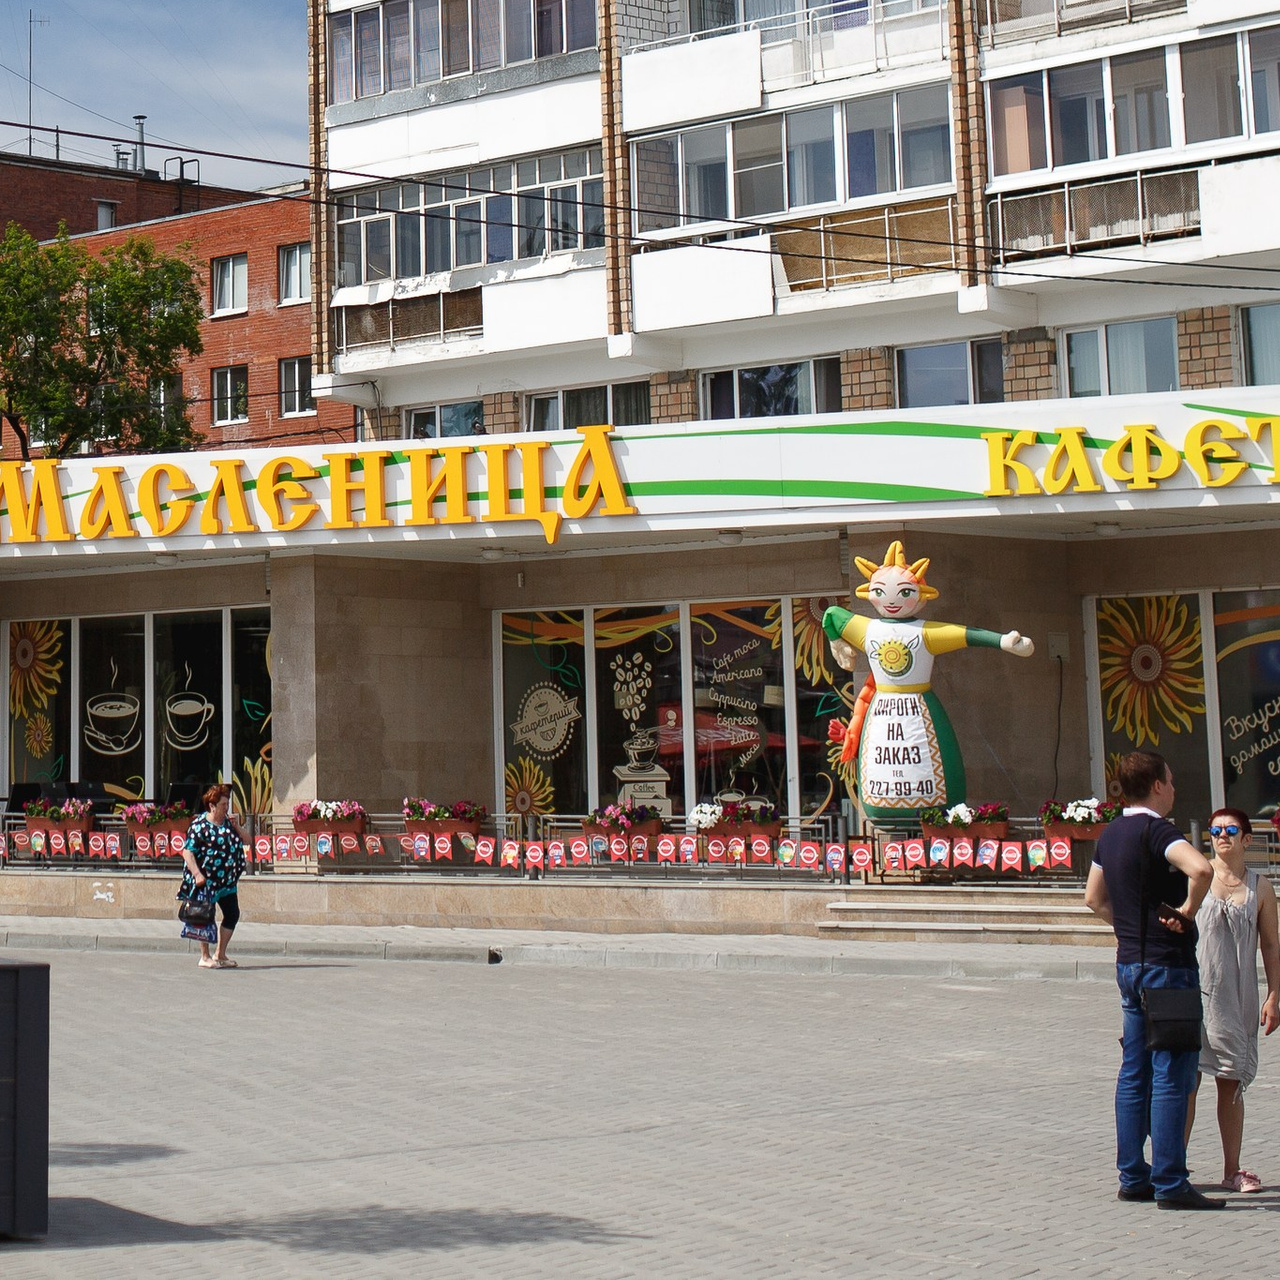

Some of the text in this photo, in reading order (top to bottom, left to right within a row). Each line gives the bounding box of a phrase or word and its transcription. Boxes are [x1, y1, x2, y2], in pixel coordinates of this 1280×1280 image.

[734, 638, 761, 659] moca
[709, 666, 763, 684] Americano
[708, 687, 758, 711] Cappucino
[519, 705, 573, 736] кафетерий
[716, 712, 759, 731] Espresso
[730, 731, 757, 746] Latte
[887, 722, 905, 741] НА
[739, 743, 760, 768] Moca
[874, 745, 922, 765] ЗАКАЗ
[869, 779, 934, 796] 227-99-40
